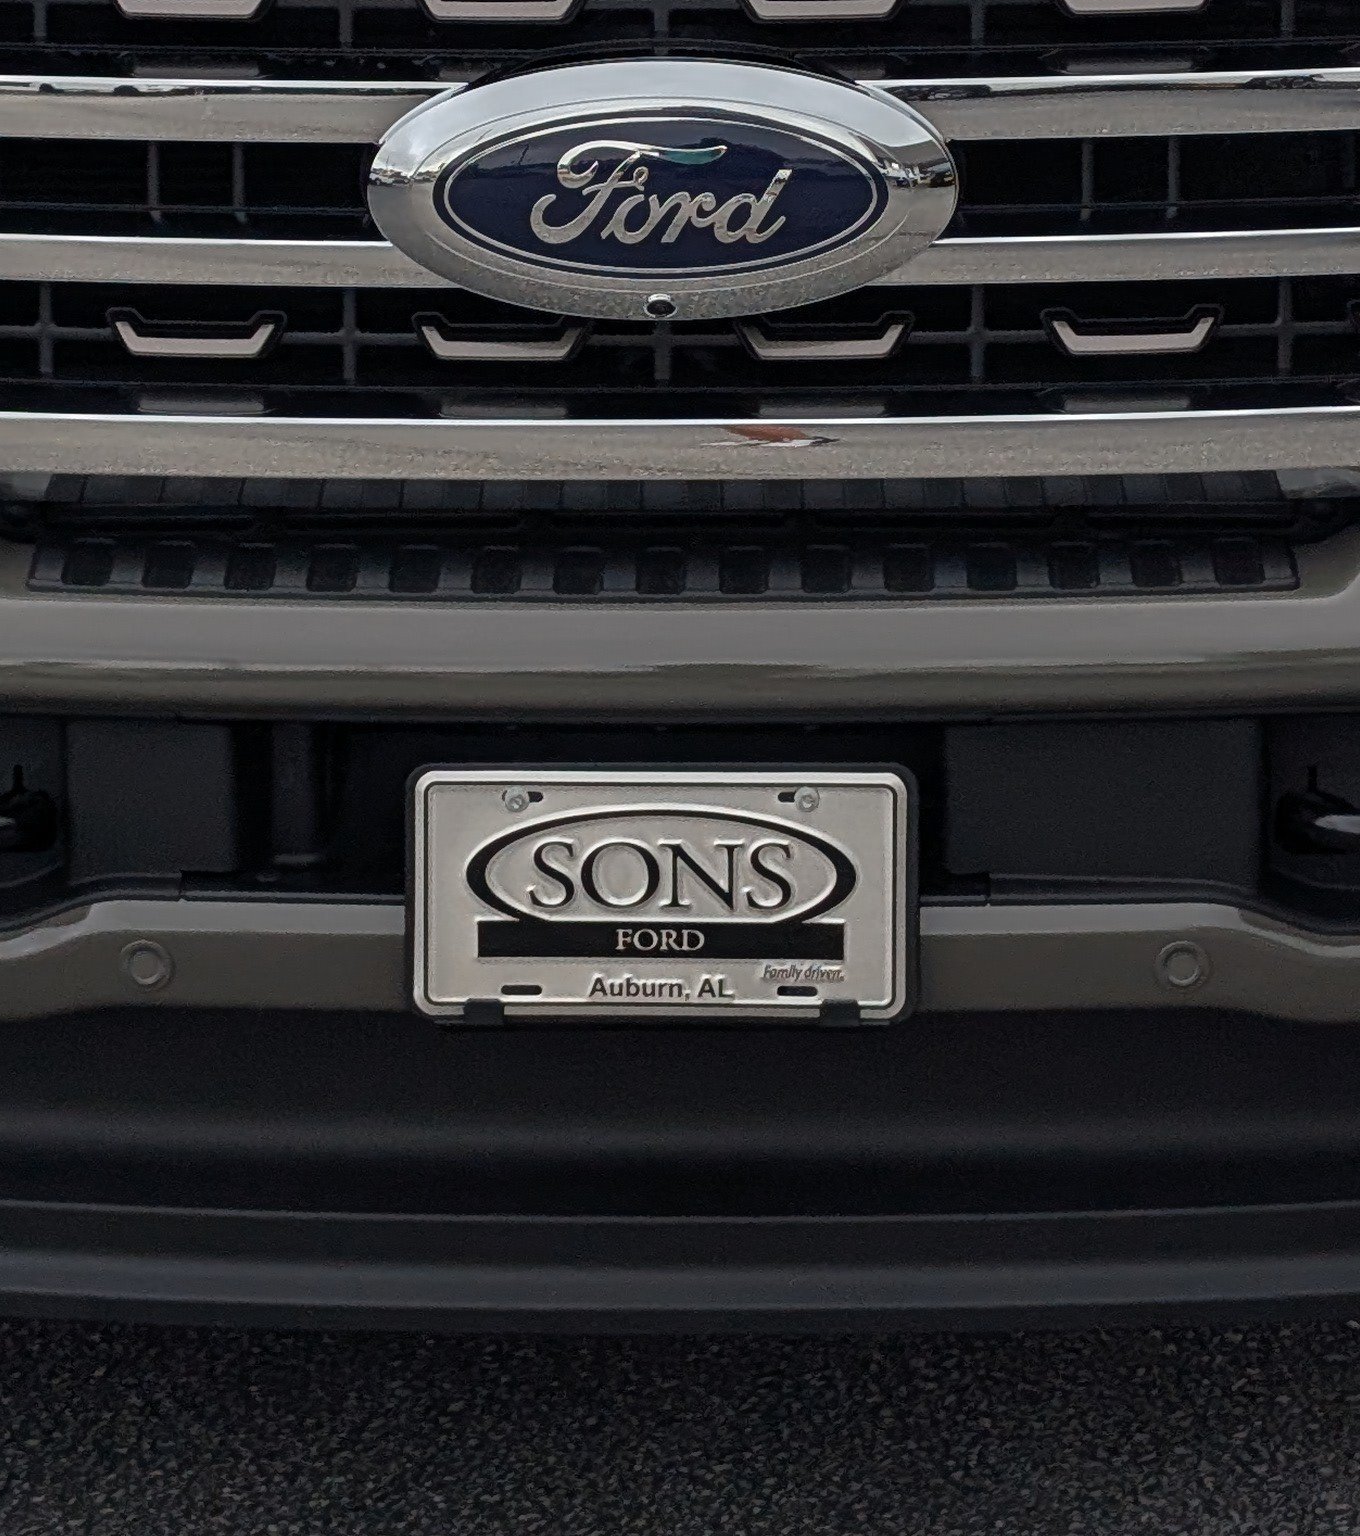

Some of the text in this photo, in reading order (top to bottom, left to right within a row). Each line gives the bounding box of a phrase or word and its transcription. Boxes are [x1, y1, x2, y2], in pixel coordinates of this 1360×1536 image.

[530, 140, 793, 244] Ford
[528, 840, 794, 910] SONS
[615, 928, 706, 952] FORD
[588, 976, 736, 1002] Auburn, AL
